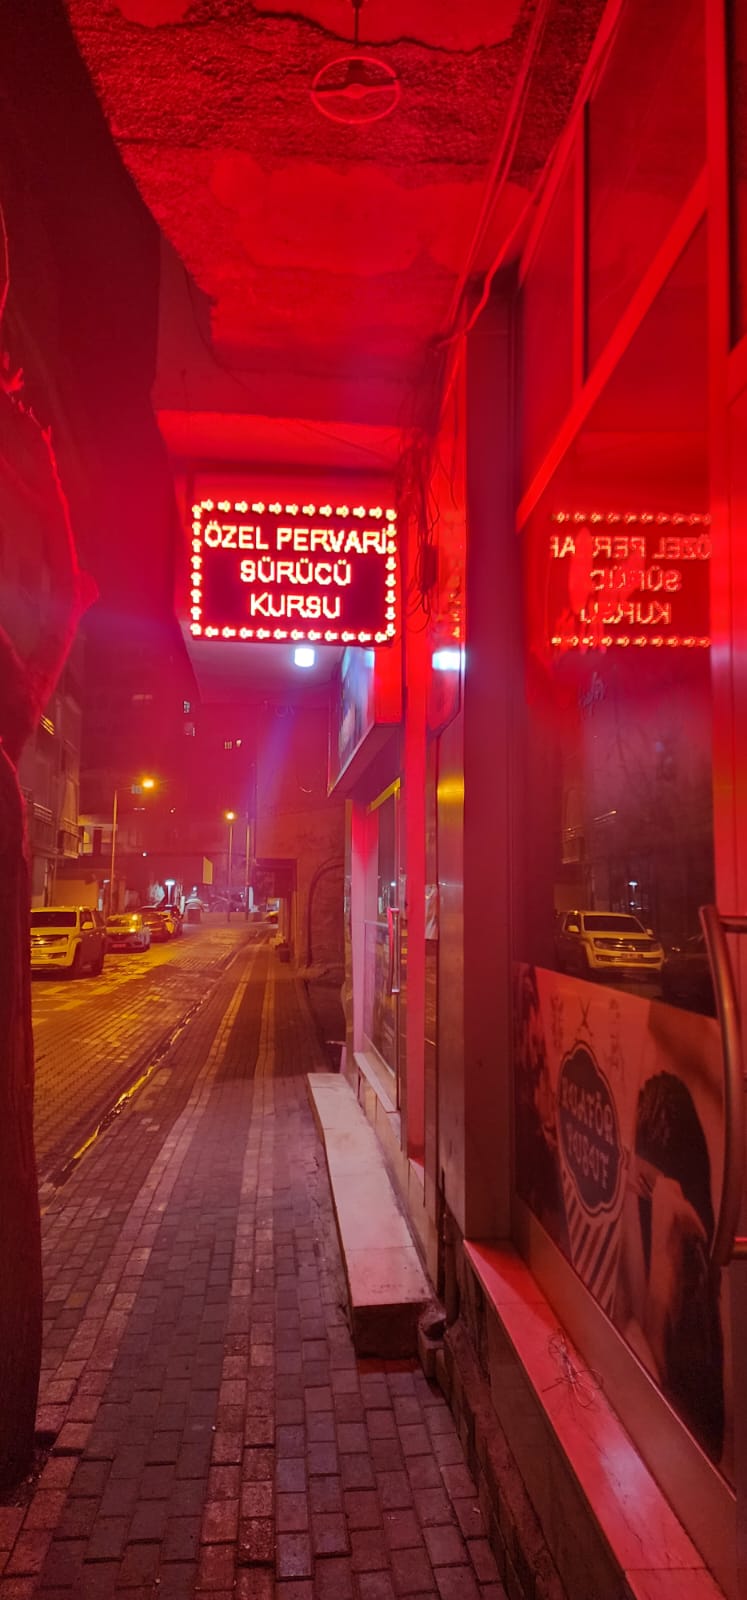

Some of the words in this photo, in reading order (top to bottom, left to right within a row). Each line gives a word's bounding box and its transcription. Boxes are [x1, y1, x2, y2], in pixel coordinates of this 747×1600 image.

[204, 520, 269, 550] ÖZEL
[276, 527, 387, 555] PERVARİ
[239, 556, 351, 586] SÜRÜCÜ
[250, 592, 340, 619] KURSU
